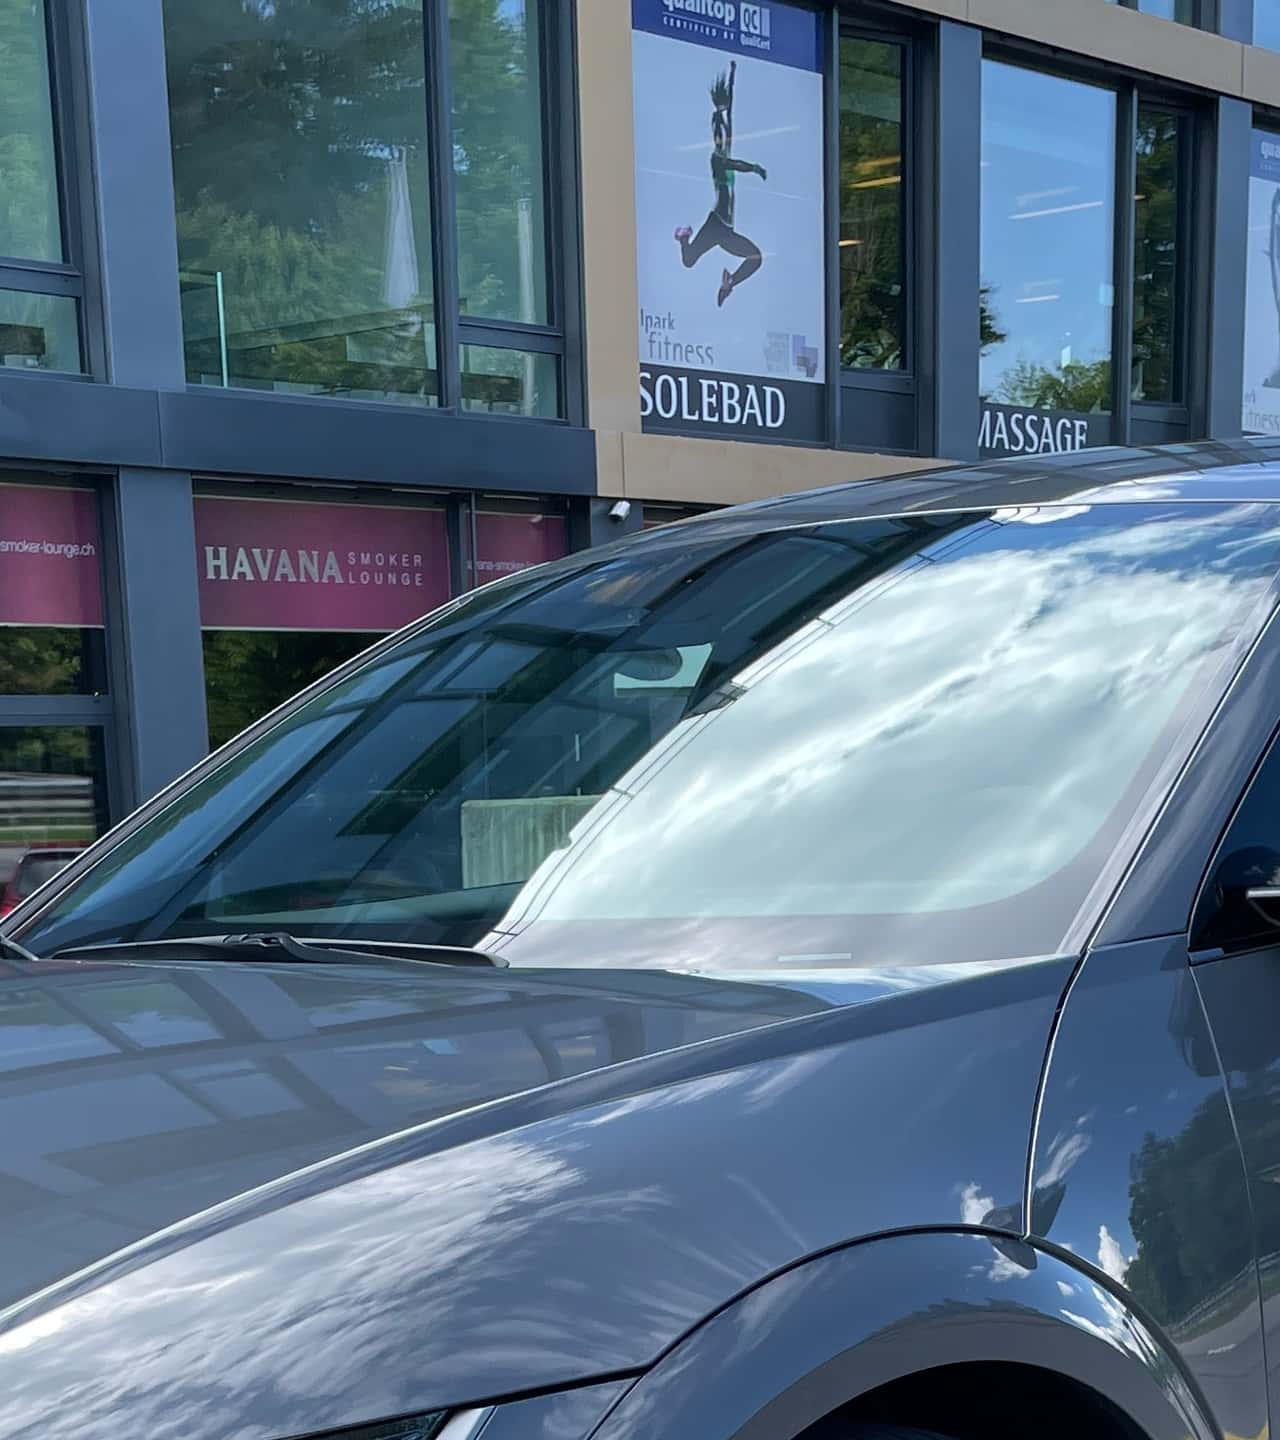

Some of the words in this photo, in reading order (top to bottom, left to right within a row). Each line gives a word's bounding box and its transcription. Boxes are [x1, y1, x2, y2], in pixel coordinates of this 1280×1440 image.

[648, 331, 714, 365] fitness
[640, 371, 785, 428] SOLEBAD
[205, 546, 344, 585] HAVANA
[347, 551, 423, 567] SMOKER
[348, 570, 423, 586] LOUNGE
